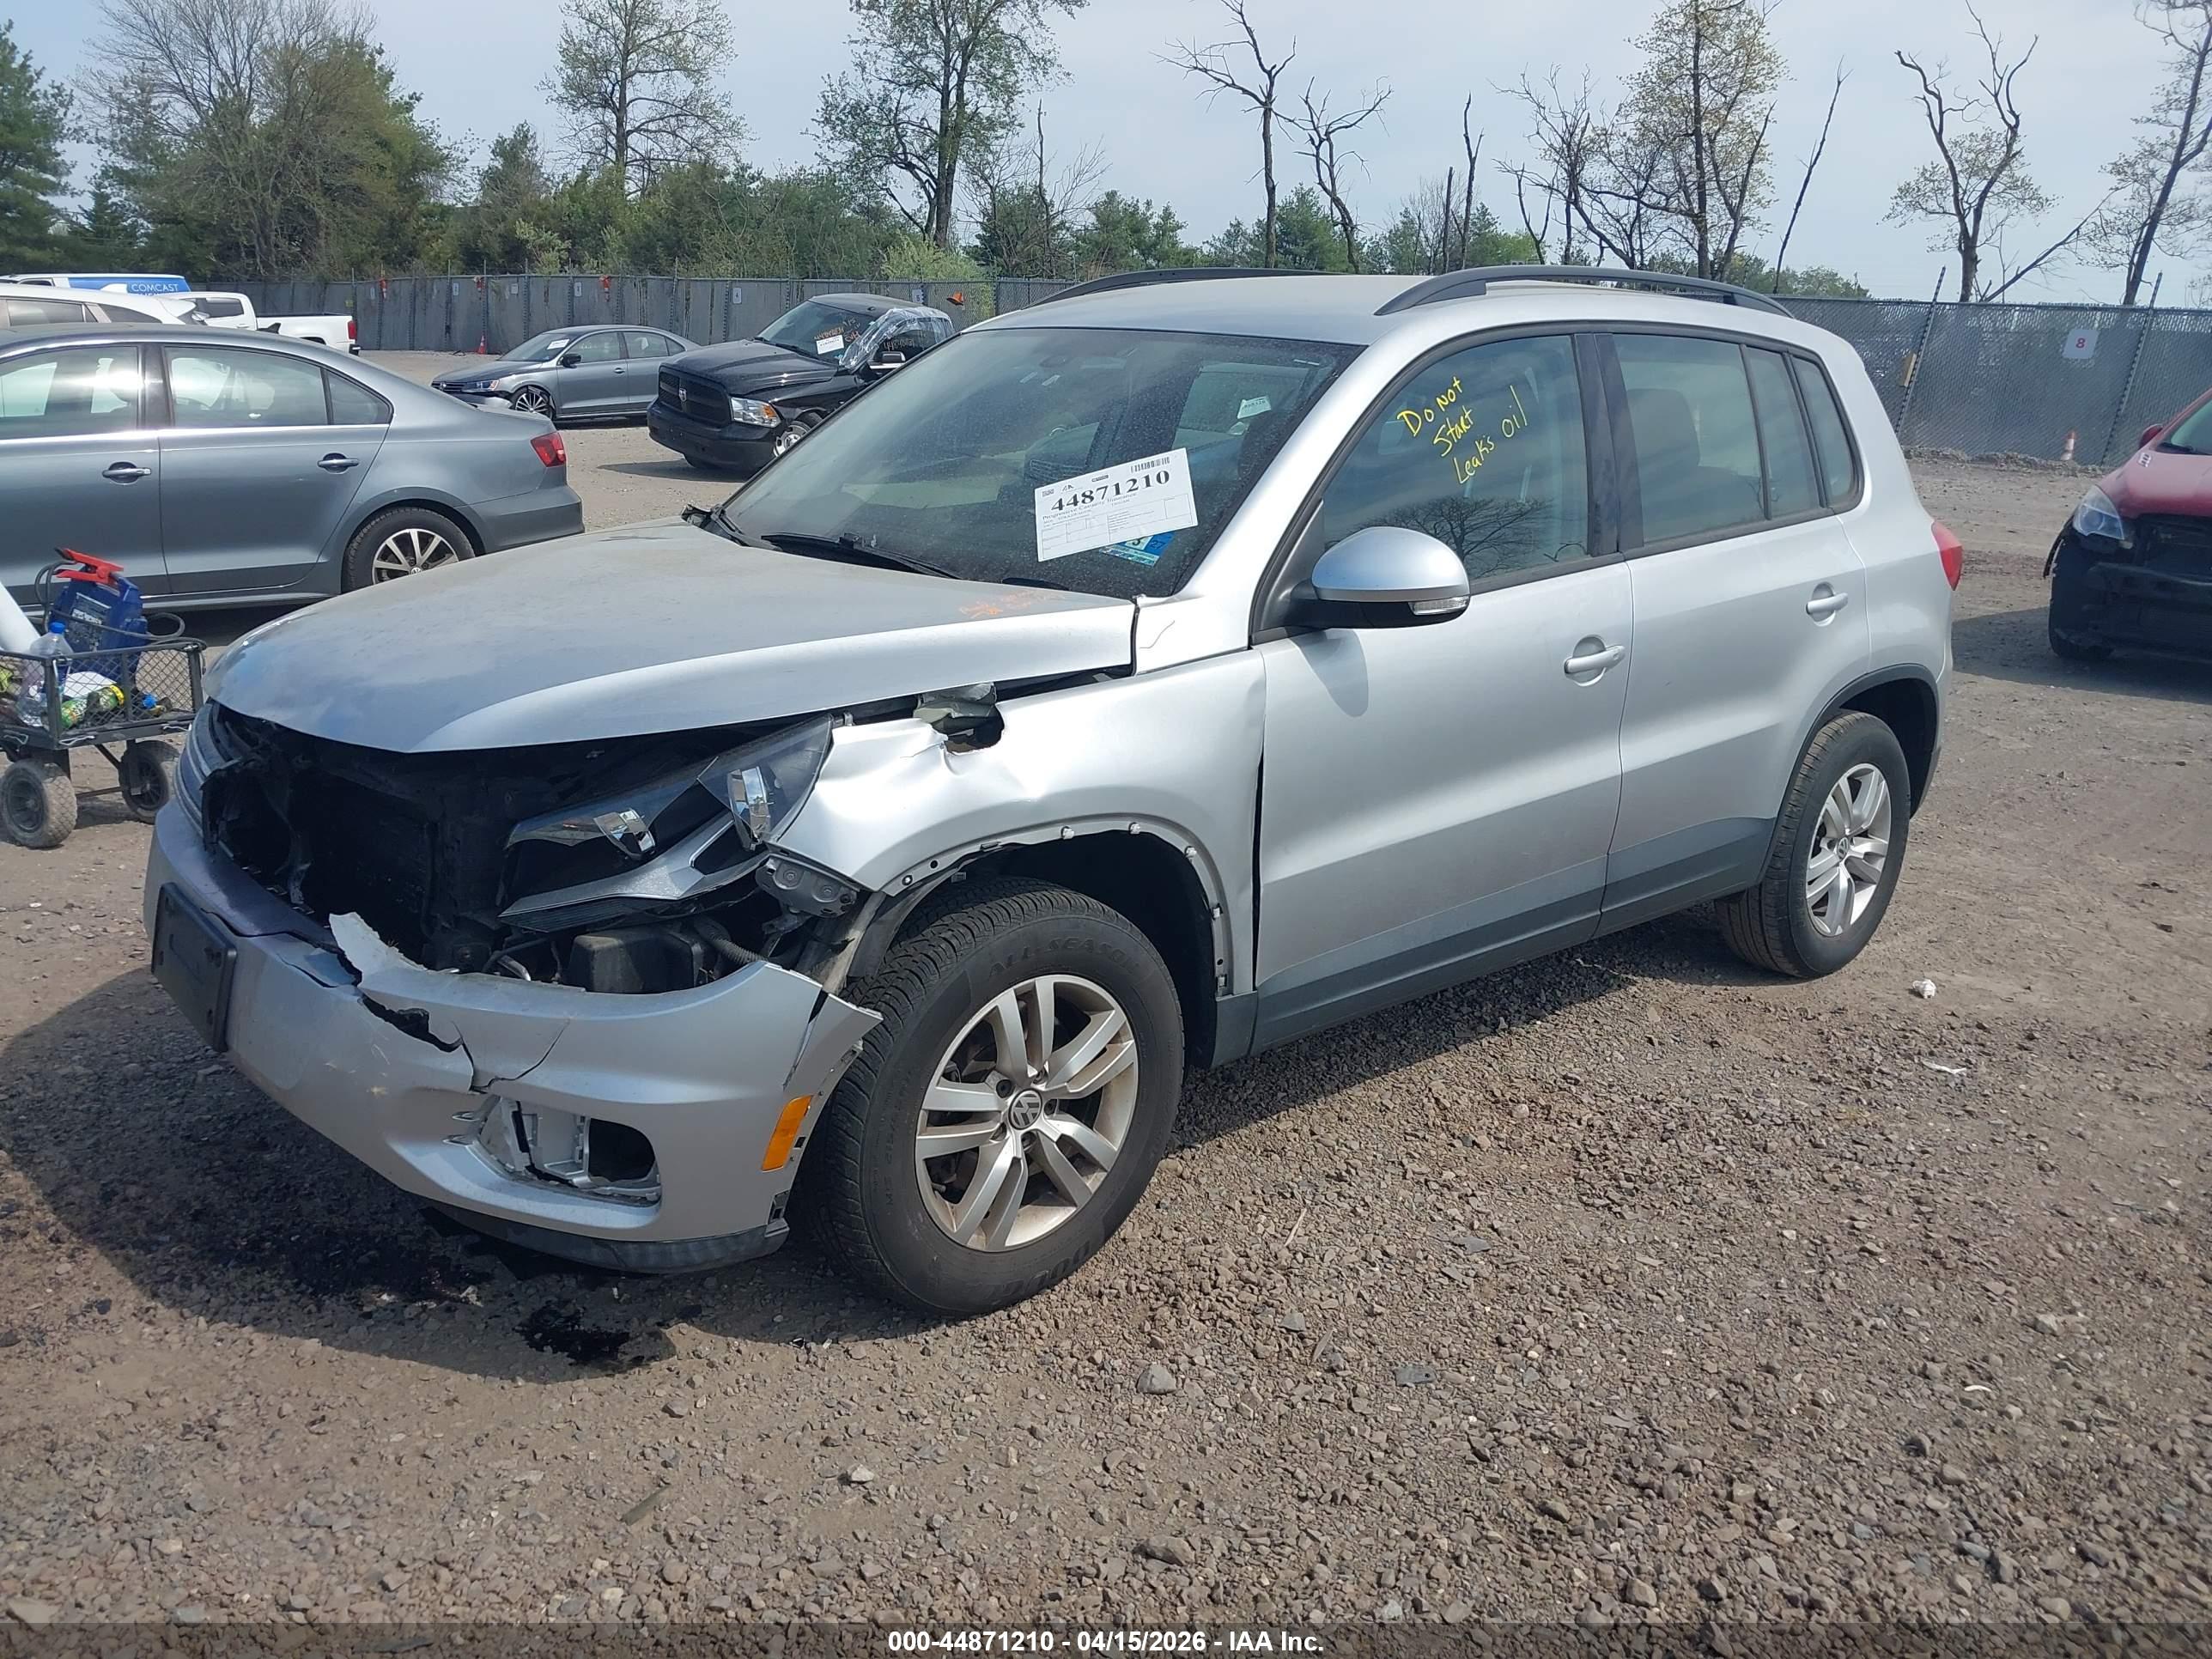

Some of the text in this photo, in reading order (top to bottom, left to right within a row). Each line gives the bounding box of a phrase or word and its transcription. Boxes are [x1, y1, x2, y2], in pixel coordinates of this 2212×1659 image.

[131, 283, 179, 293] COMCAST
[2075, 337, 2086, 349] 8
[1396, 409, 1435, 437] Do
[1453, 435, 1495, 484] Leaks
[1051, 470, 1170, 511] 44871210
[1042, 507, 1079, 520] Progressive
